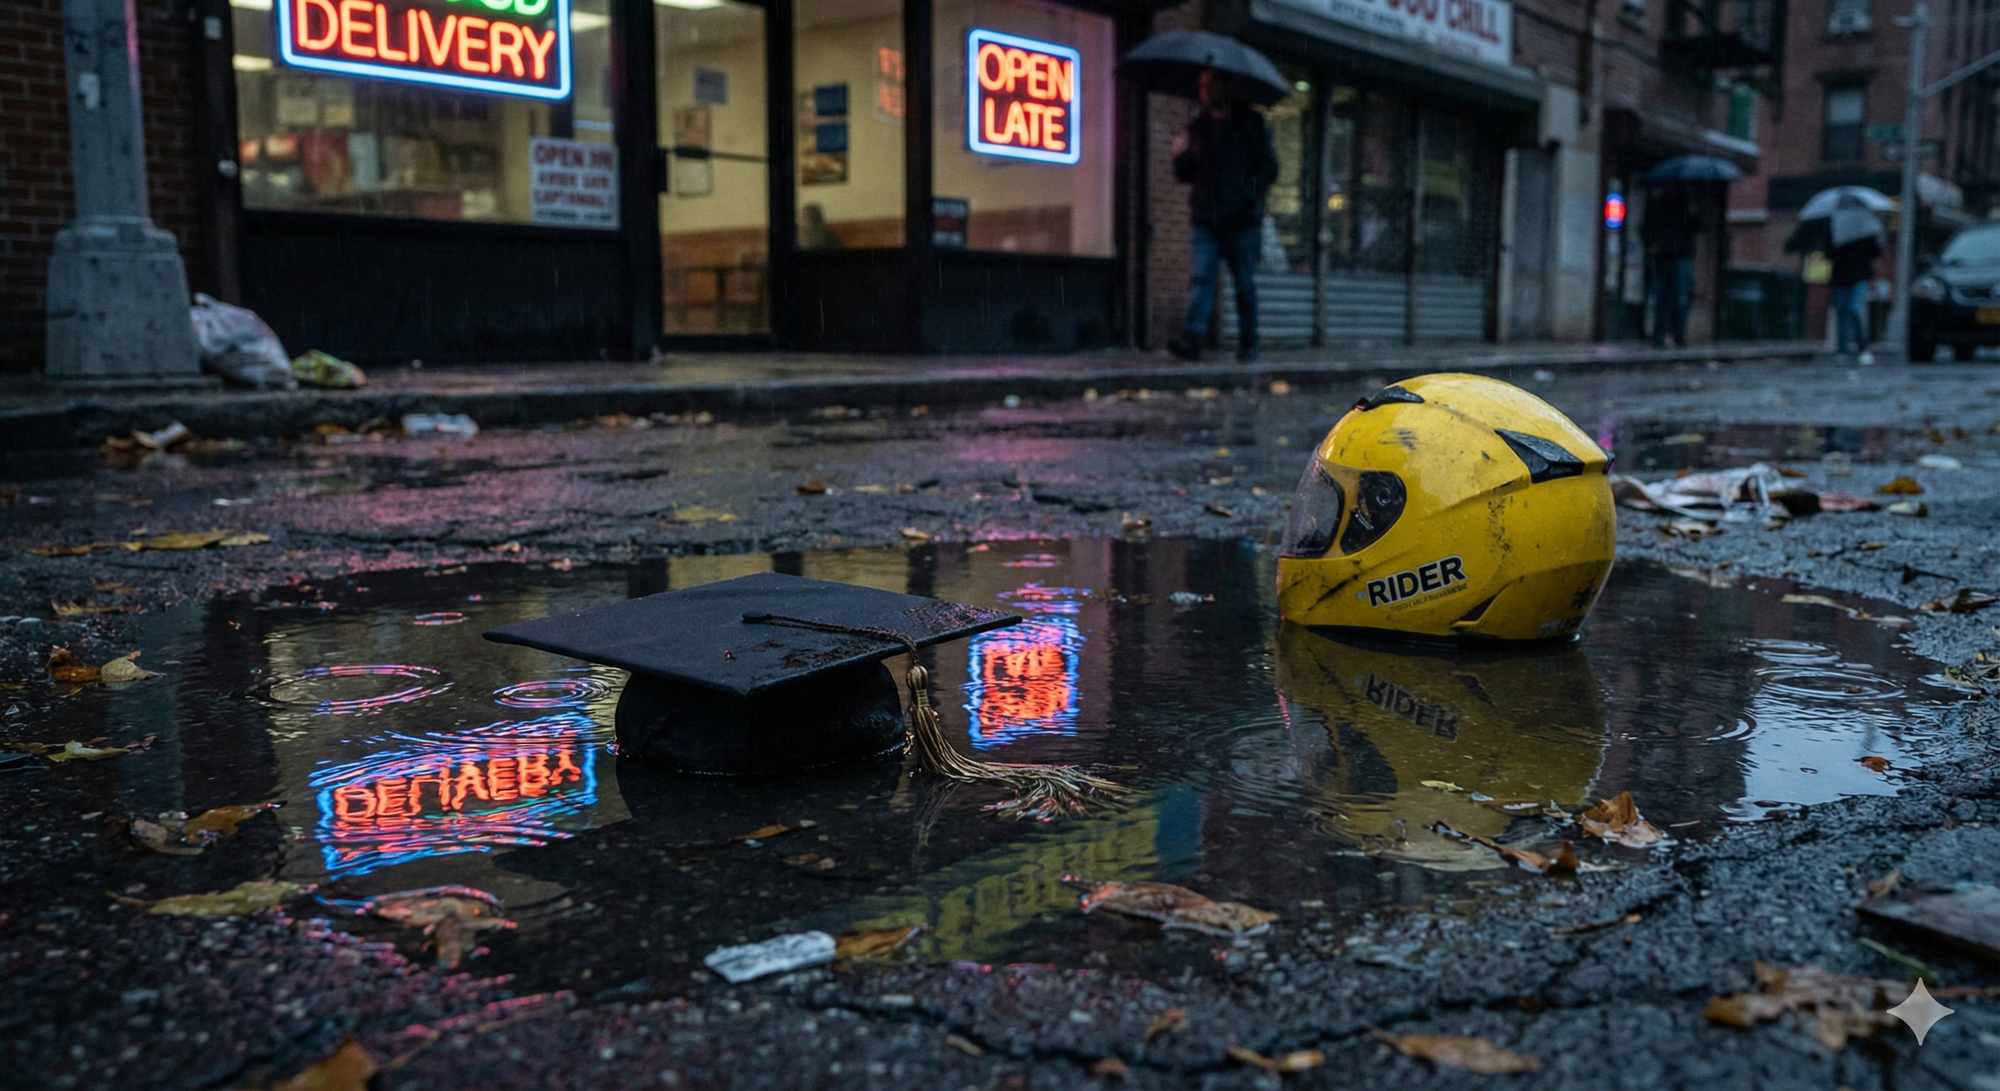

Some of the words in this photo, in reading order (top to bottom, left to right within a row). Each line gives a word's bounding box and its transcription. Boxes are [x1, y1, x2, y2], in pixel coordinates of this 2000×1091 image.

[296, 0, 556, 80] DELIVERY
[977, 42, 1074, 103] OPEN
[984, 96, 1067, 151] LATE
[1366, 555, 1468, 607] RIDER
